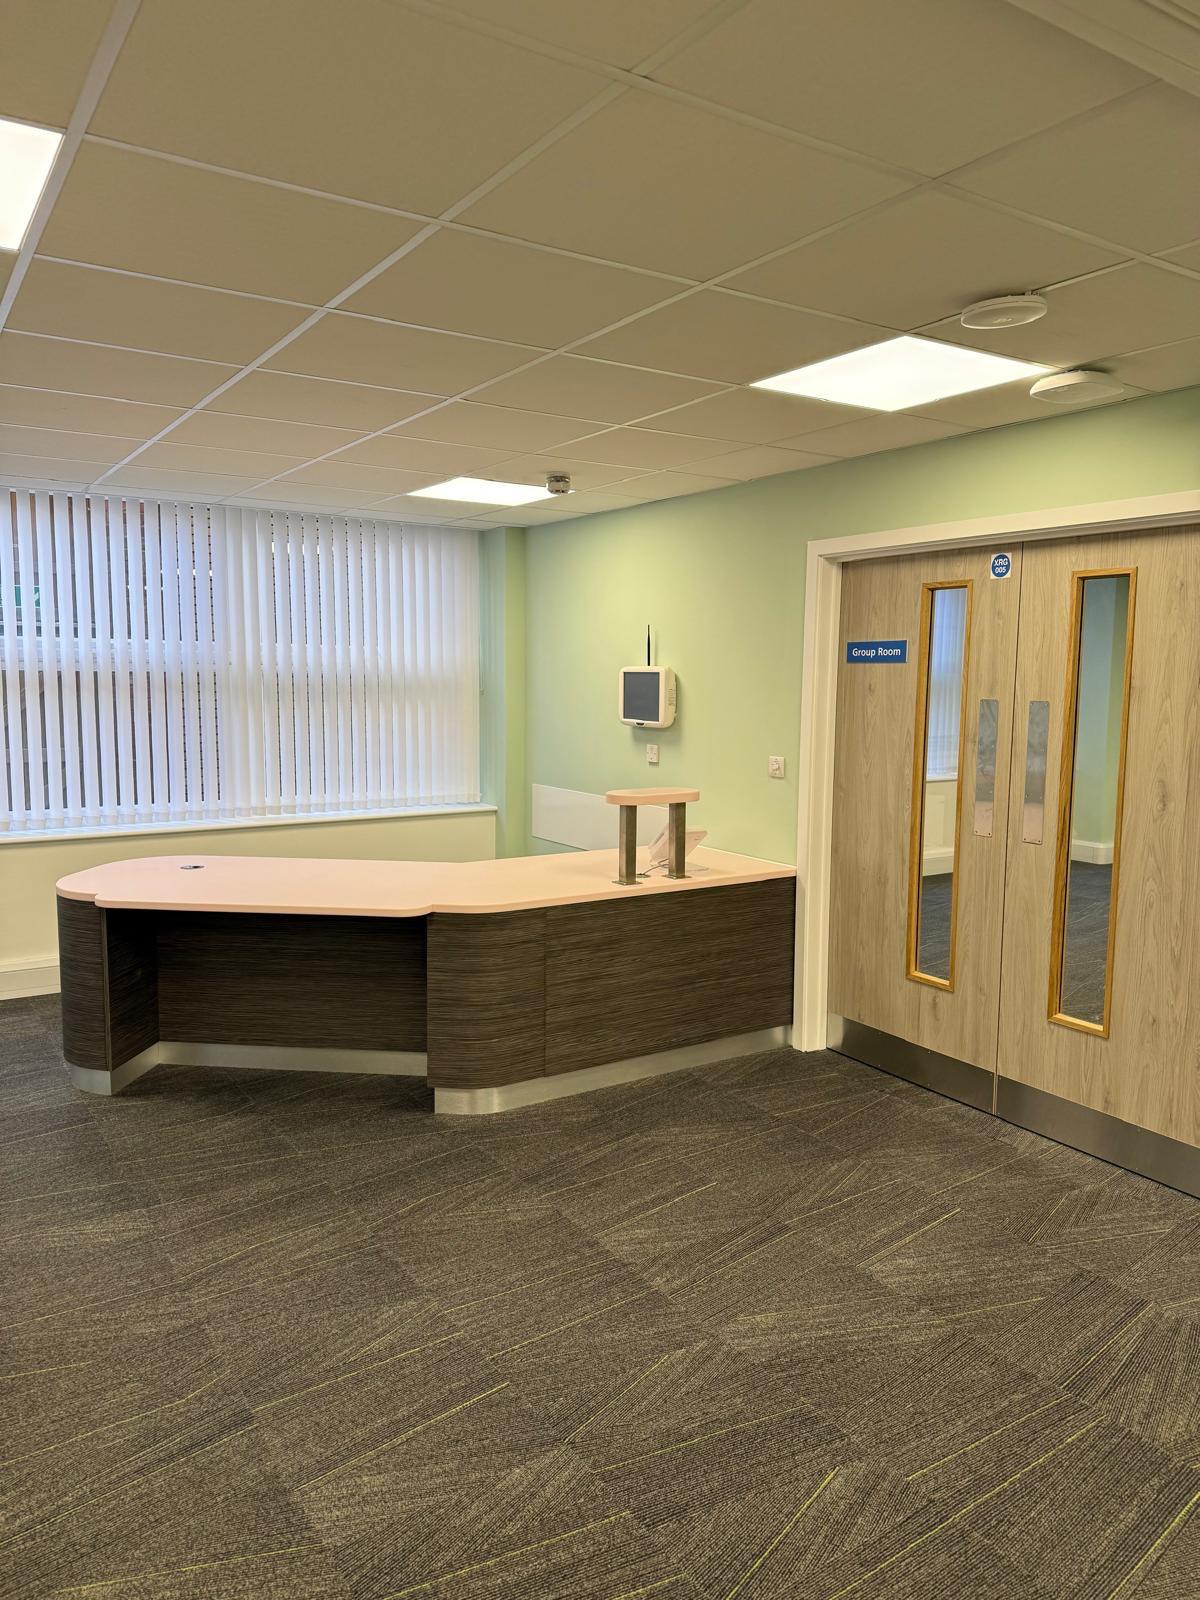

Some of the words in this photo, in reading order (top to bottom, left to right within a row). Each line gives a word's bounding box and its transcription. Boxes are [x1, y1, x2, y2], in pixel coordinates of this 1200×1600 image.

[994, 558, 1008, 566] XRG
[995, 566, 1006, 574] 005
[852, 648, 876, 658] Group
[878, 647, 901, 656] Room
